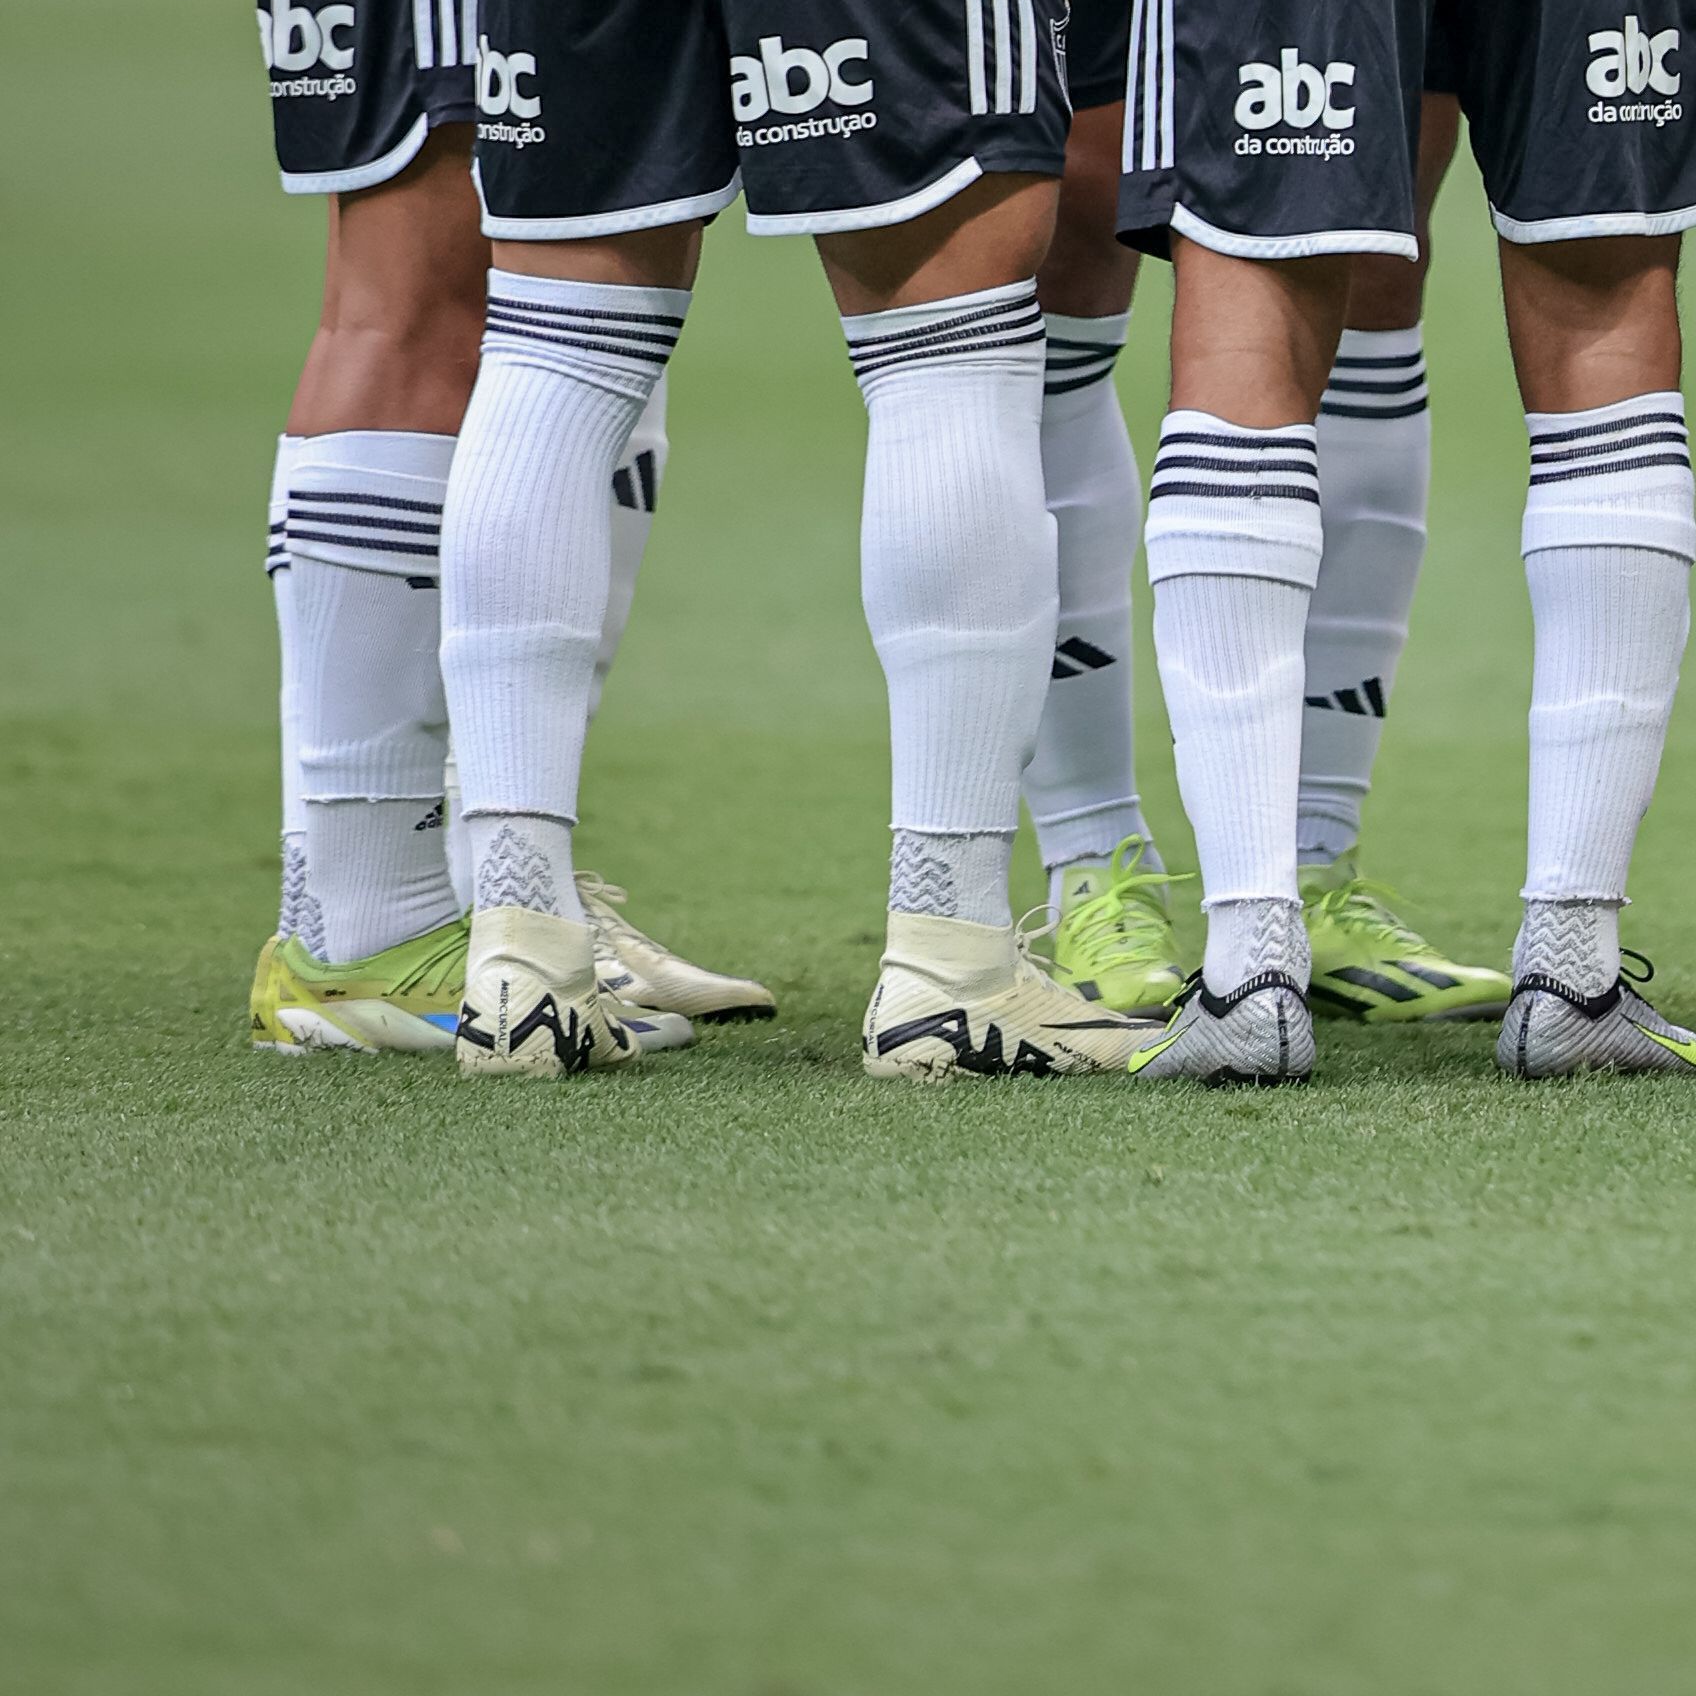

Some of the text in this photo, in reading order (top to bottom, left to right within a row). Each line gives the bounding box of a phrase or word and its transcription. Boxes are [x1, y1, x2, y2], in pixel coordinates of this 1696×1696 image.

[475, 33, 542, 119] bc
[730, 35, 874, 123] abc
[1234, 47, 1356, 130] abc
[1585, 15, 1681, 98] abc
[1234, 133, 1356, 162] da construção
[1588, 101, 1618, 123] da
